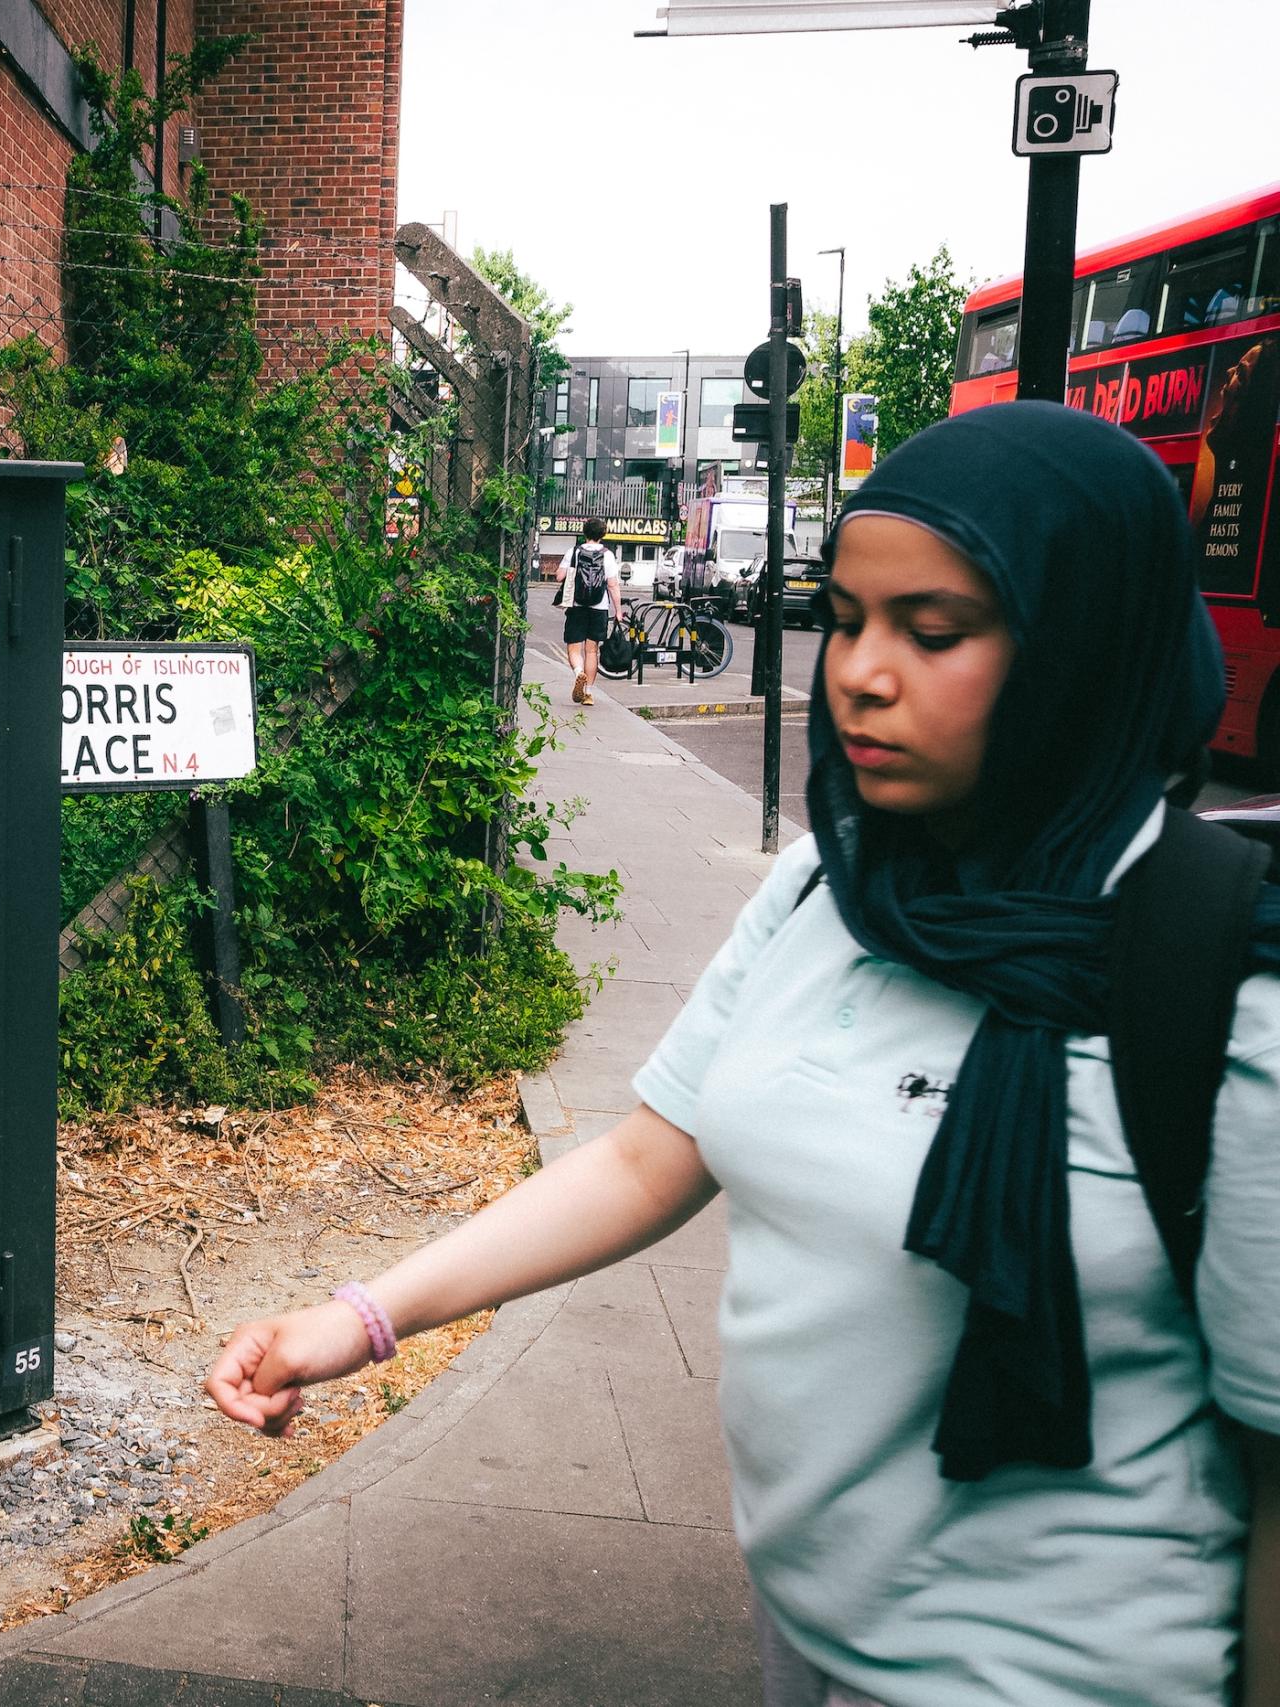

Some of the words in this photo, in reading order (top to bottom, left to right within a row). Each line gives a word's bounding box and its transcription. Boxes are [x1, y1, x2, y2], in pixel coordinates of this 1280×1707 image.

[1142, 364, 1205, 420] BURN
[1218, 484, 1242, 497] EVERY
[1213, 504, 1242, 517] FAMILY
[606, 518, 667, 535] MINICABS
[1210, 524, 1225, 537] HAS
[1227, 524, 1239, 537] ITS
[1206, 544, 1238, 556] DEMONS
[122, 660, 142, 675] OF
[154, 660, 240, 675] ISLINGTON
[62, 734, 154, 776] ACE
[15, 1346, 40, 1374] 55
